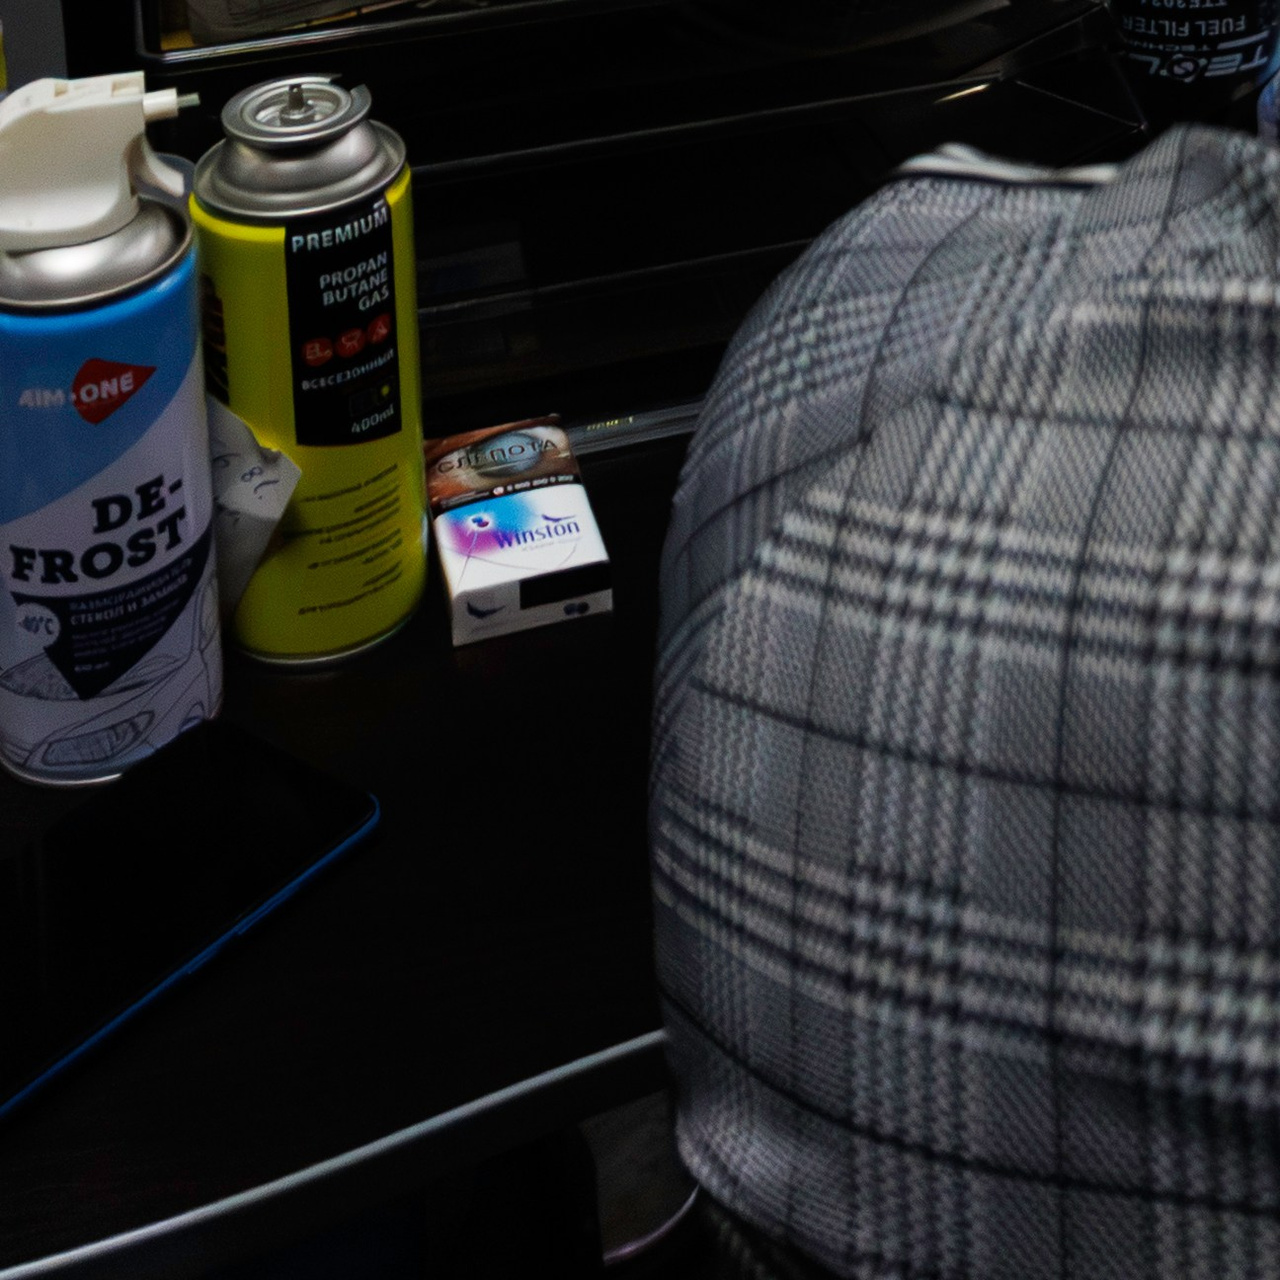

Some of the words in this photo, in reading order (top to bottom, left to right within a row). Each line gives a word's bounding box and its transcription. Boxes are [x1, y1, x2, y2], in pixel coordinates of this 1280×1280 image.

[1121, 14, 1190, 38] FILTER
[1194, 14, 1247, 37] FUEL
[291, 206, 389, 254] PREMIUM
[319, 250, 387, 290] PROPAN
[322, 267, 389, 307] BUTANE
[357, 284, 390, 311] GAS
[80, 371, 135, 404] ONE
[301, 348, 395, 391] ВСЕСЕЗОННЫЙ
[91, 474, 184, 534] DE-
[9, 505, 186, 584] FROST
[493, 520, 581, 550] Winston
